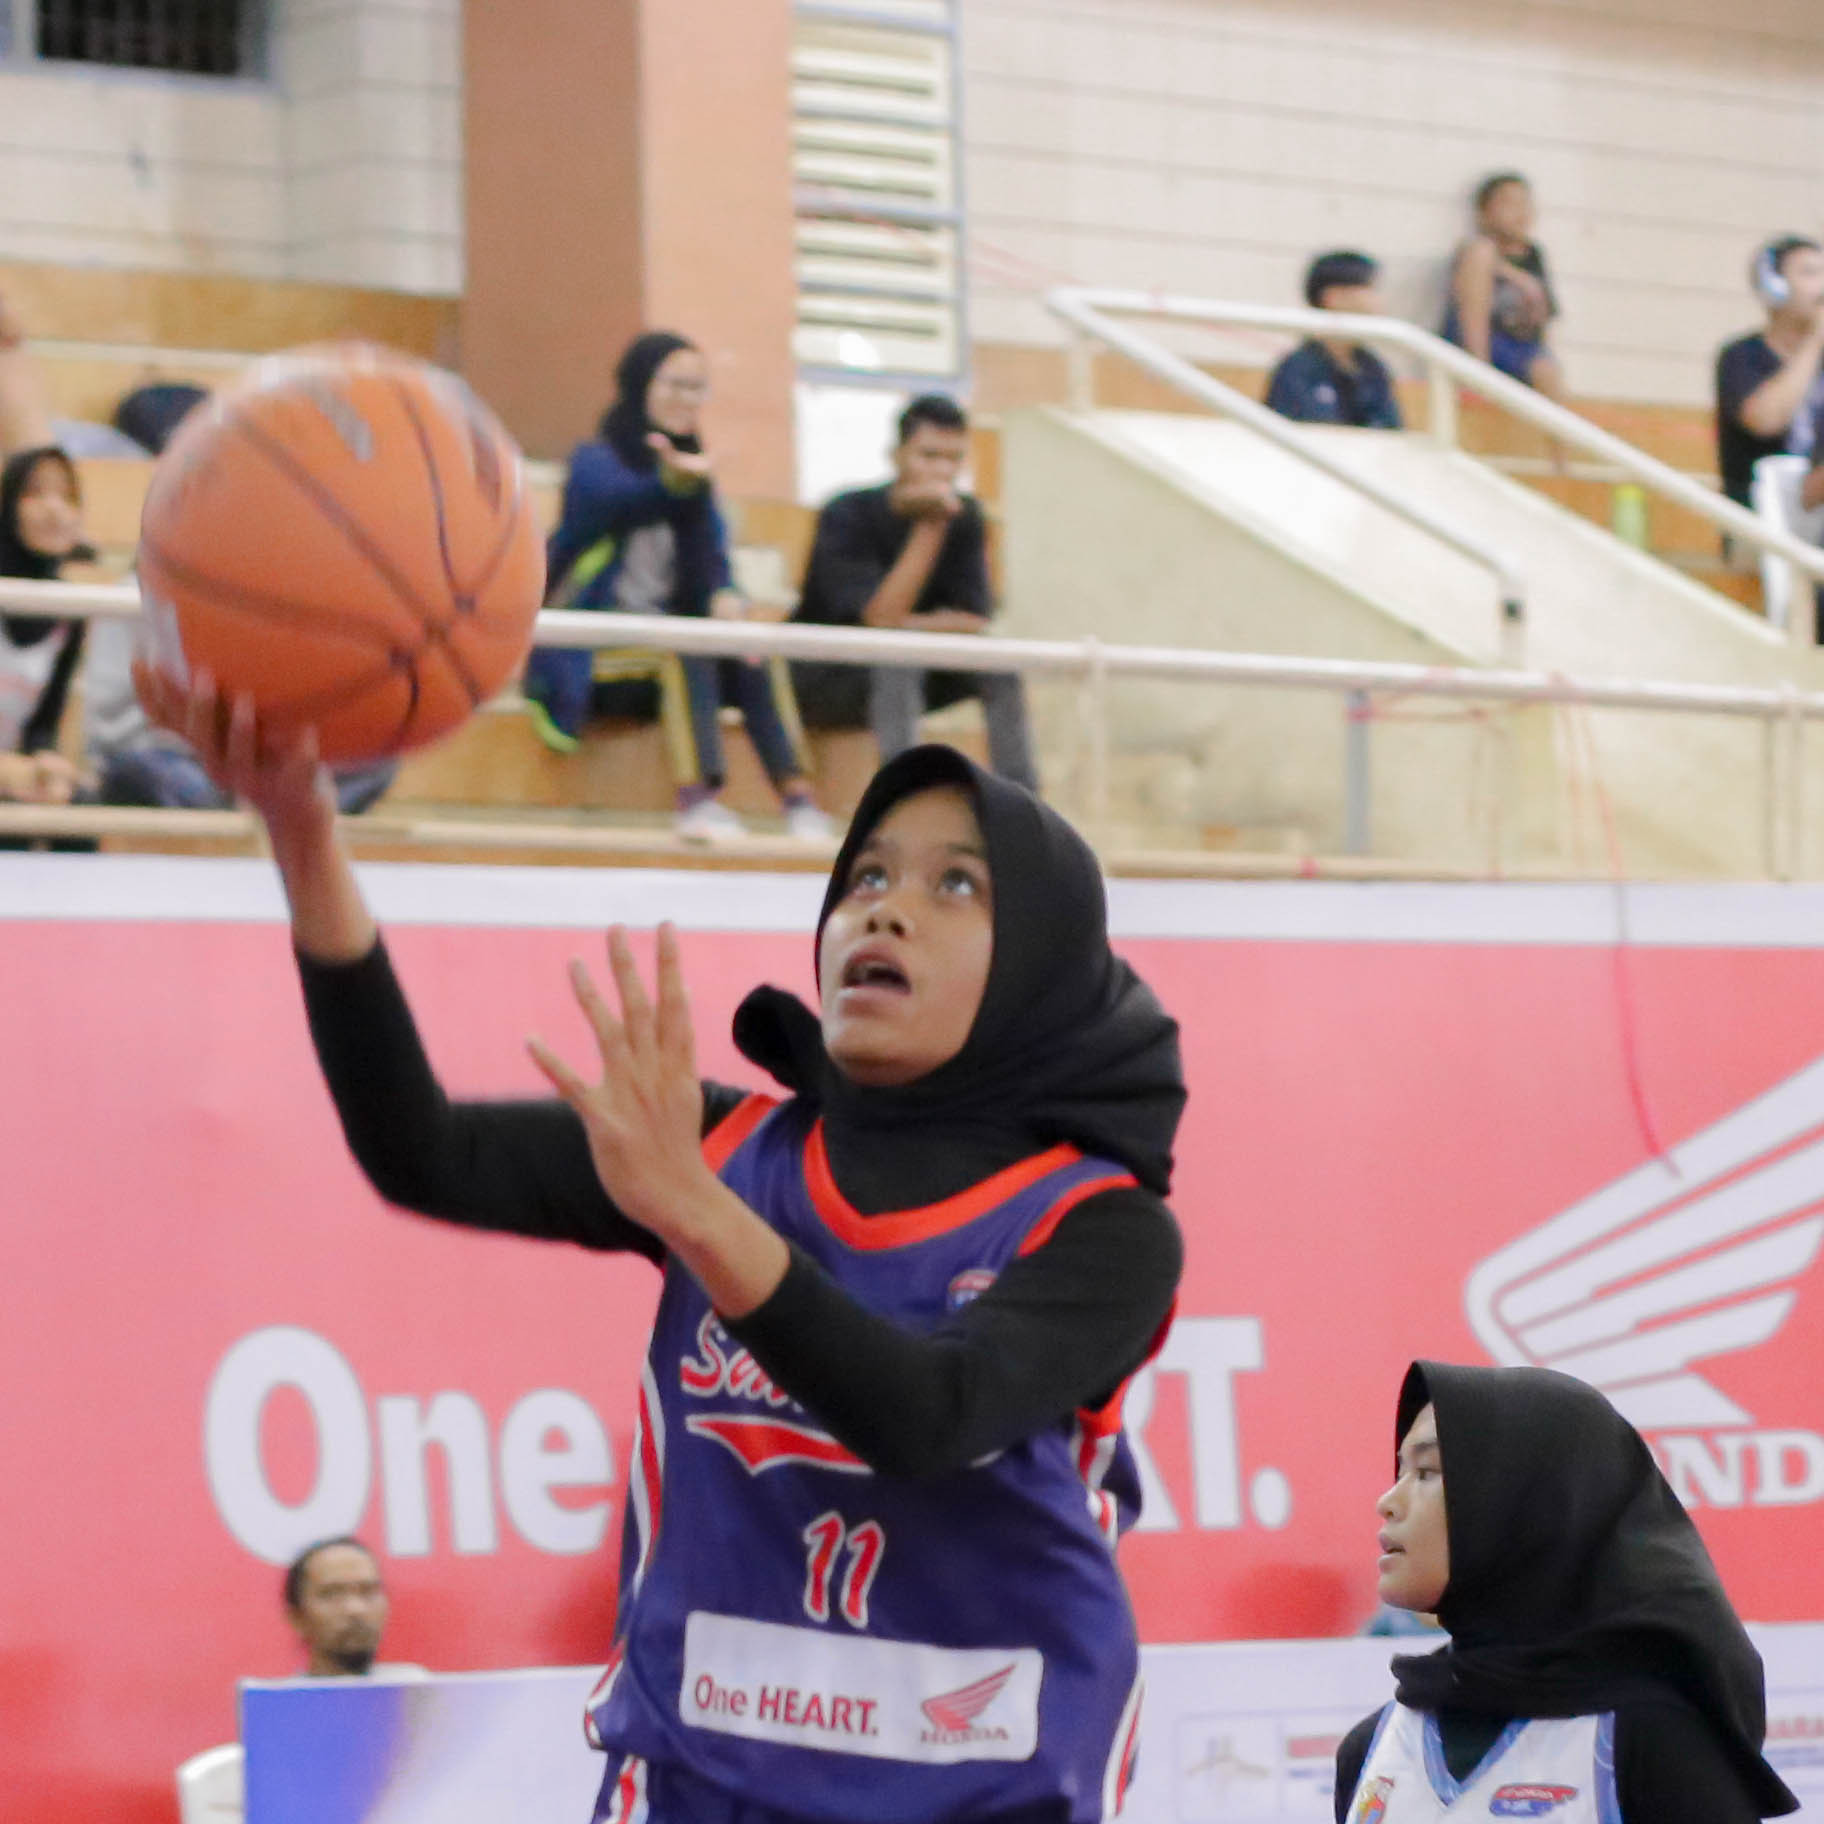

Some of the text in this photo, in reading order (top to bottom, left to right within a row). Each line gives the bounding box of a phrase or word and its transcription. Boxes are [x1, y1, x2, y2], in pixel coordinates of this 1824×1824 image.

[203, 1322, 615, 1568] One
[802, 1510, 886, 1630] 11
[694, 1673, 880, 1738] One HEART.
